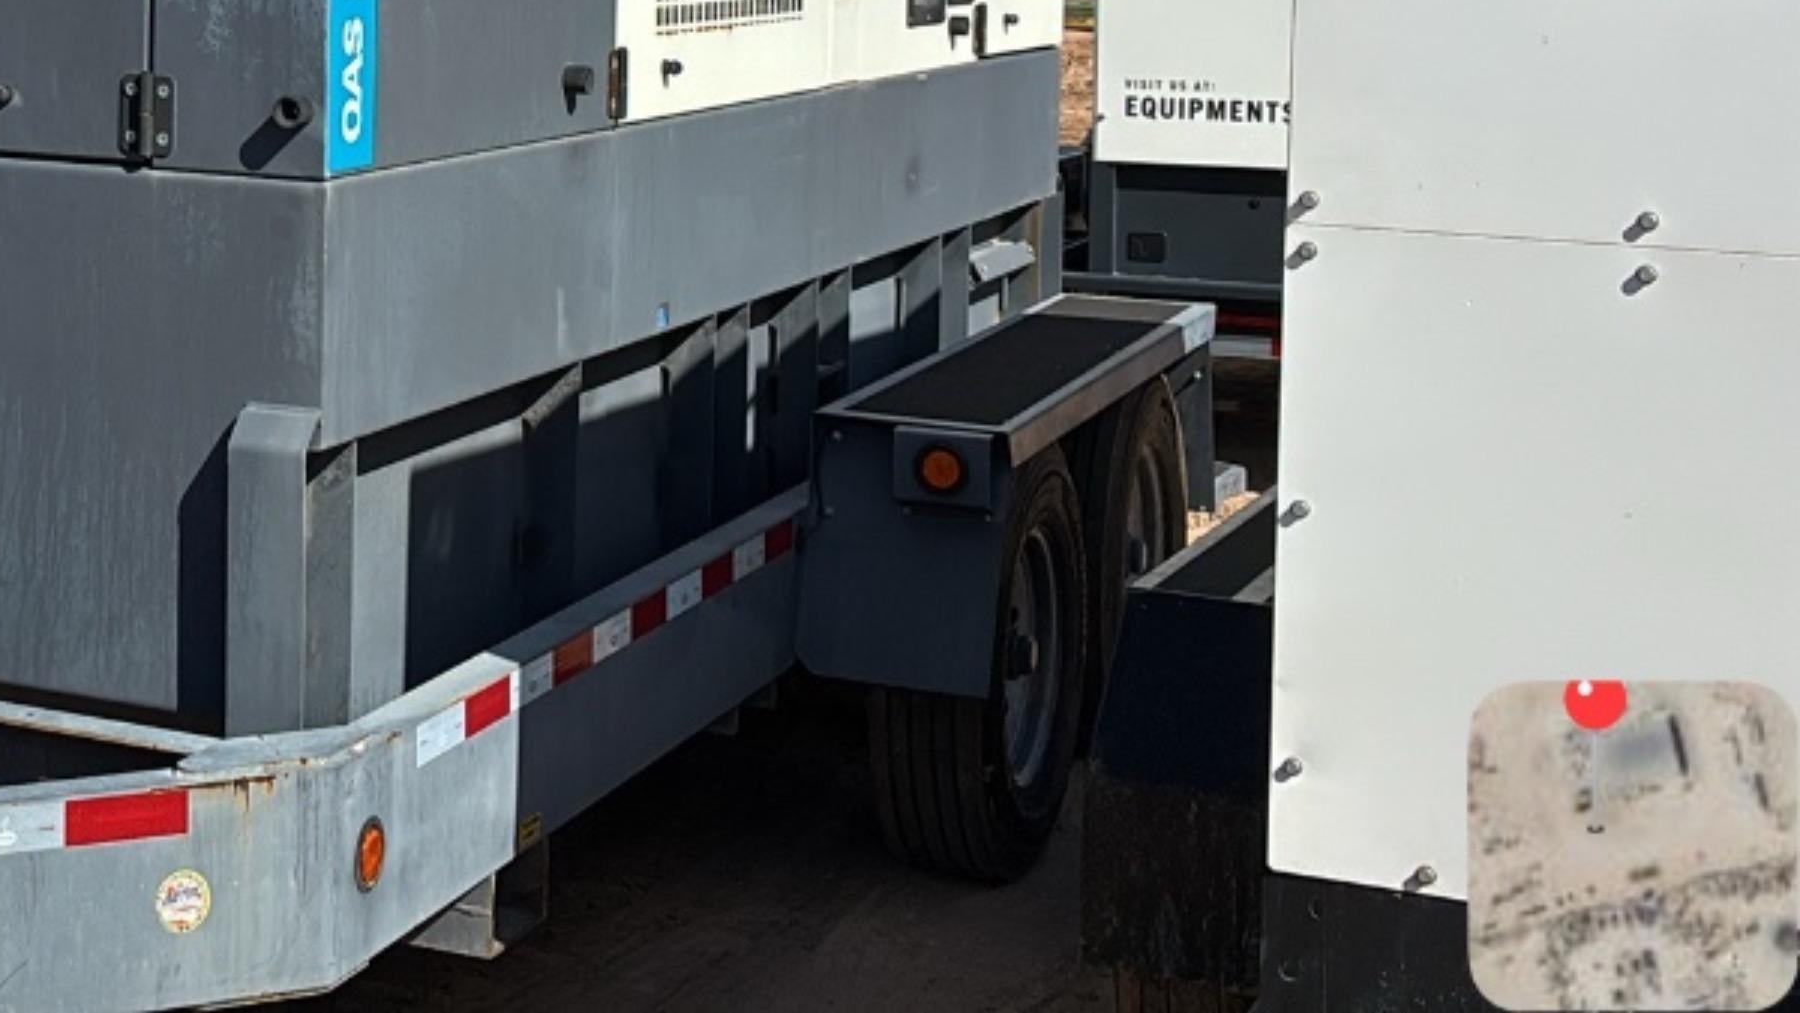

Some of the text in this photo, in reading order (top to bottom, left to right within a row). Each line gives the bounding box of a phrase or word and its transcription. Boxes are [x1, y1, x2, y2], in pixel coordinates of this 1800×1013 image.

[340, 16, 365, 144] QAS
[1124, 79, 1163, 91] VISIT
[1169, 80, 1187, 92] US
